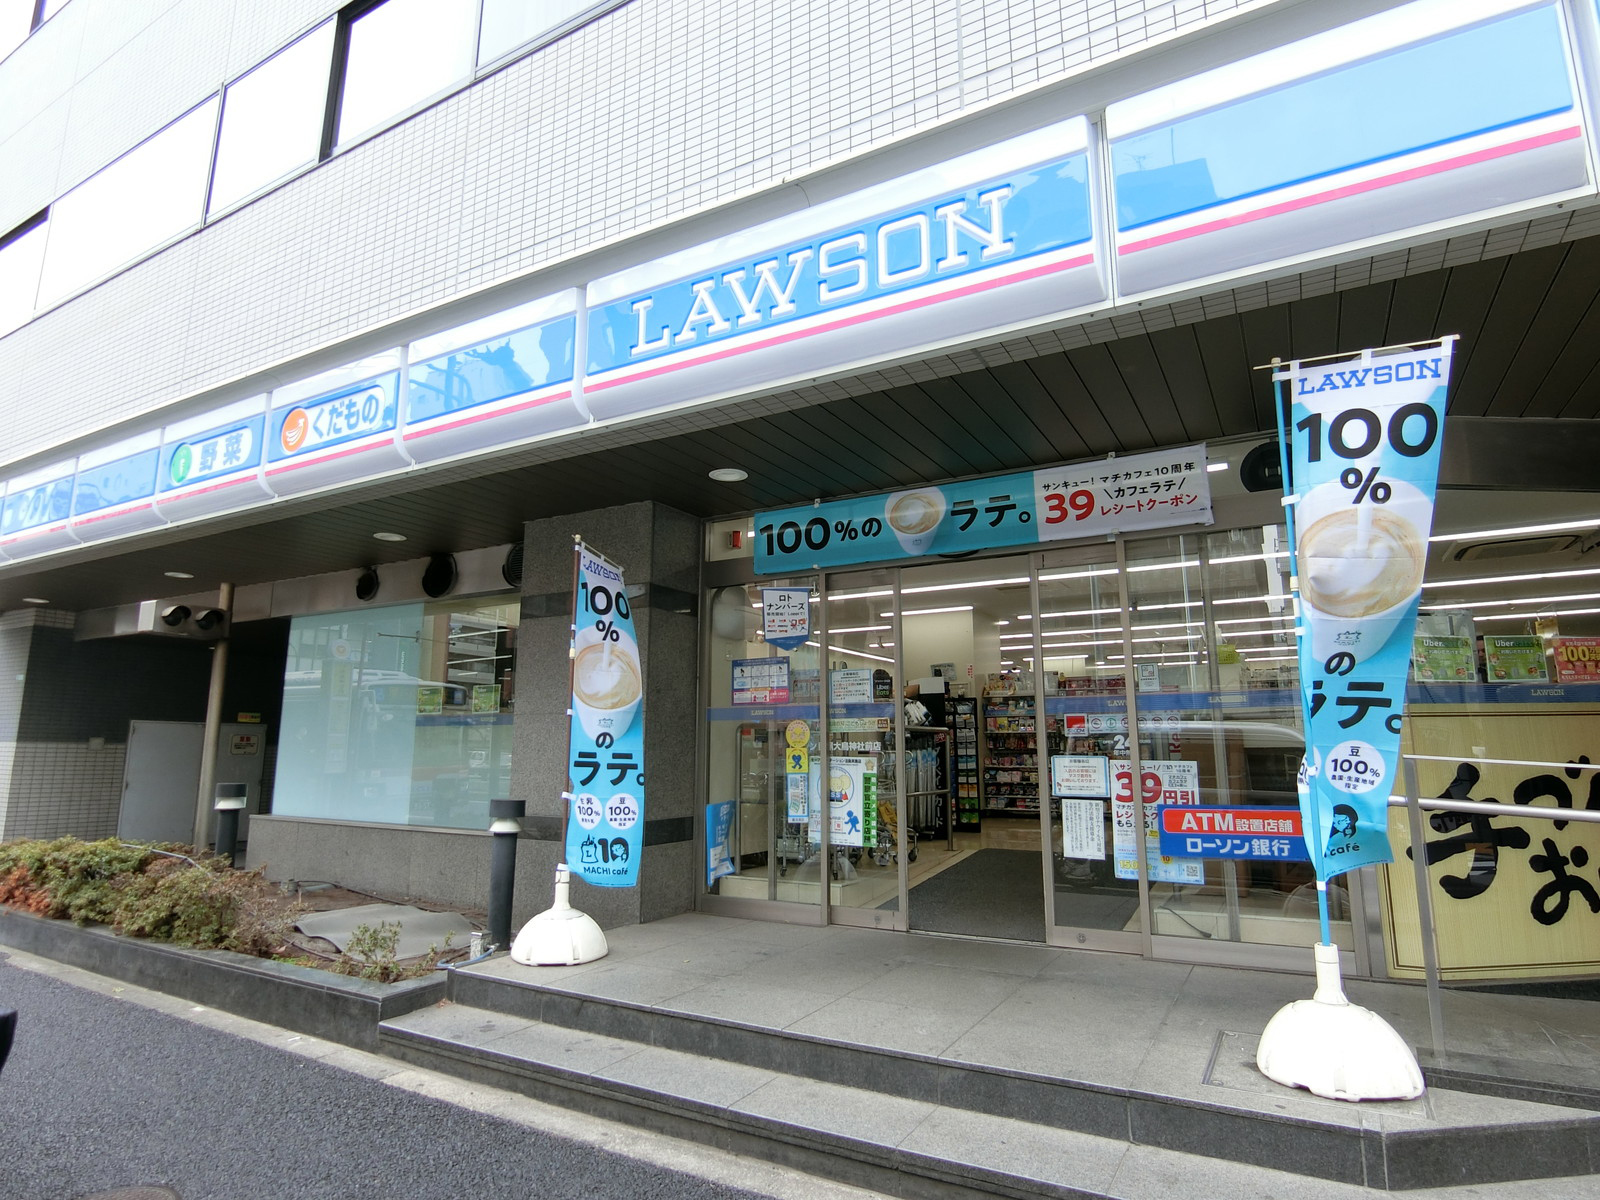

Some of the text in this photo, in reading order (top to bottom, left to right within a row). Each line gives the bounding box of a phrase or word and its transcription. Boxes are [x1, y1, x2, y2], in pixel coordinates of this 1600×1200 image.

[629, 183, 1014, 358] LAWSON
[1298, 358, 1442, 395] LAWSON
[311, 393, 379, 439] くだもの
[1296, 402, 1438, 463] 100
[199, 431, 244, 472] 野菜
[1099, 462, 1195, 484] マチカフェ10周年
[1339, 466, 1392, 505] %
[1043, 489, 1095, 524] 39
[1100, 493, 1198, 516] レシートクーポン
[759, 496, 1032, 556] 100%の ラテ。
[580, 581, 630, 620] 100
[766, 602, 805, 610] ナンバーズ
[779, 594, 792, 602] ロト
[595, 620, 620, 643] %
[1423, 639, 1443, 647] Uber
[1495, 639, 1514, 647] Uber
[1324, 651, 1357, 676] の
[1530, 688, 1565, 696] LAWSON
[595, 731, 614, 749] の
[1348, 746, 1361, 757] 豆
[573, 751, 645, 787] ラテ。
[1331, 758, 1381, 778] 100%
[1115, 771, 1162, 804] 39
[609, 806, 637, 816] 100%
[1181, 812, 1294, 833] ATM設置店舗
[1186, 837, 1291, 857] ローソン銀行
[1330, 842, 1360, 857] café
[583, 866, 628, 875] MACHI café
